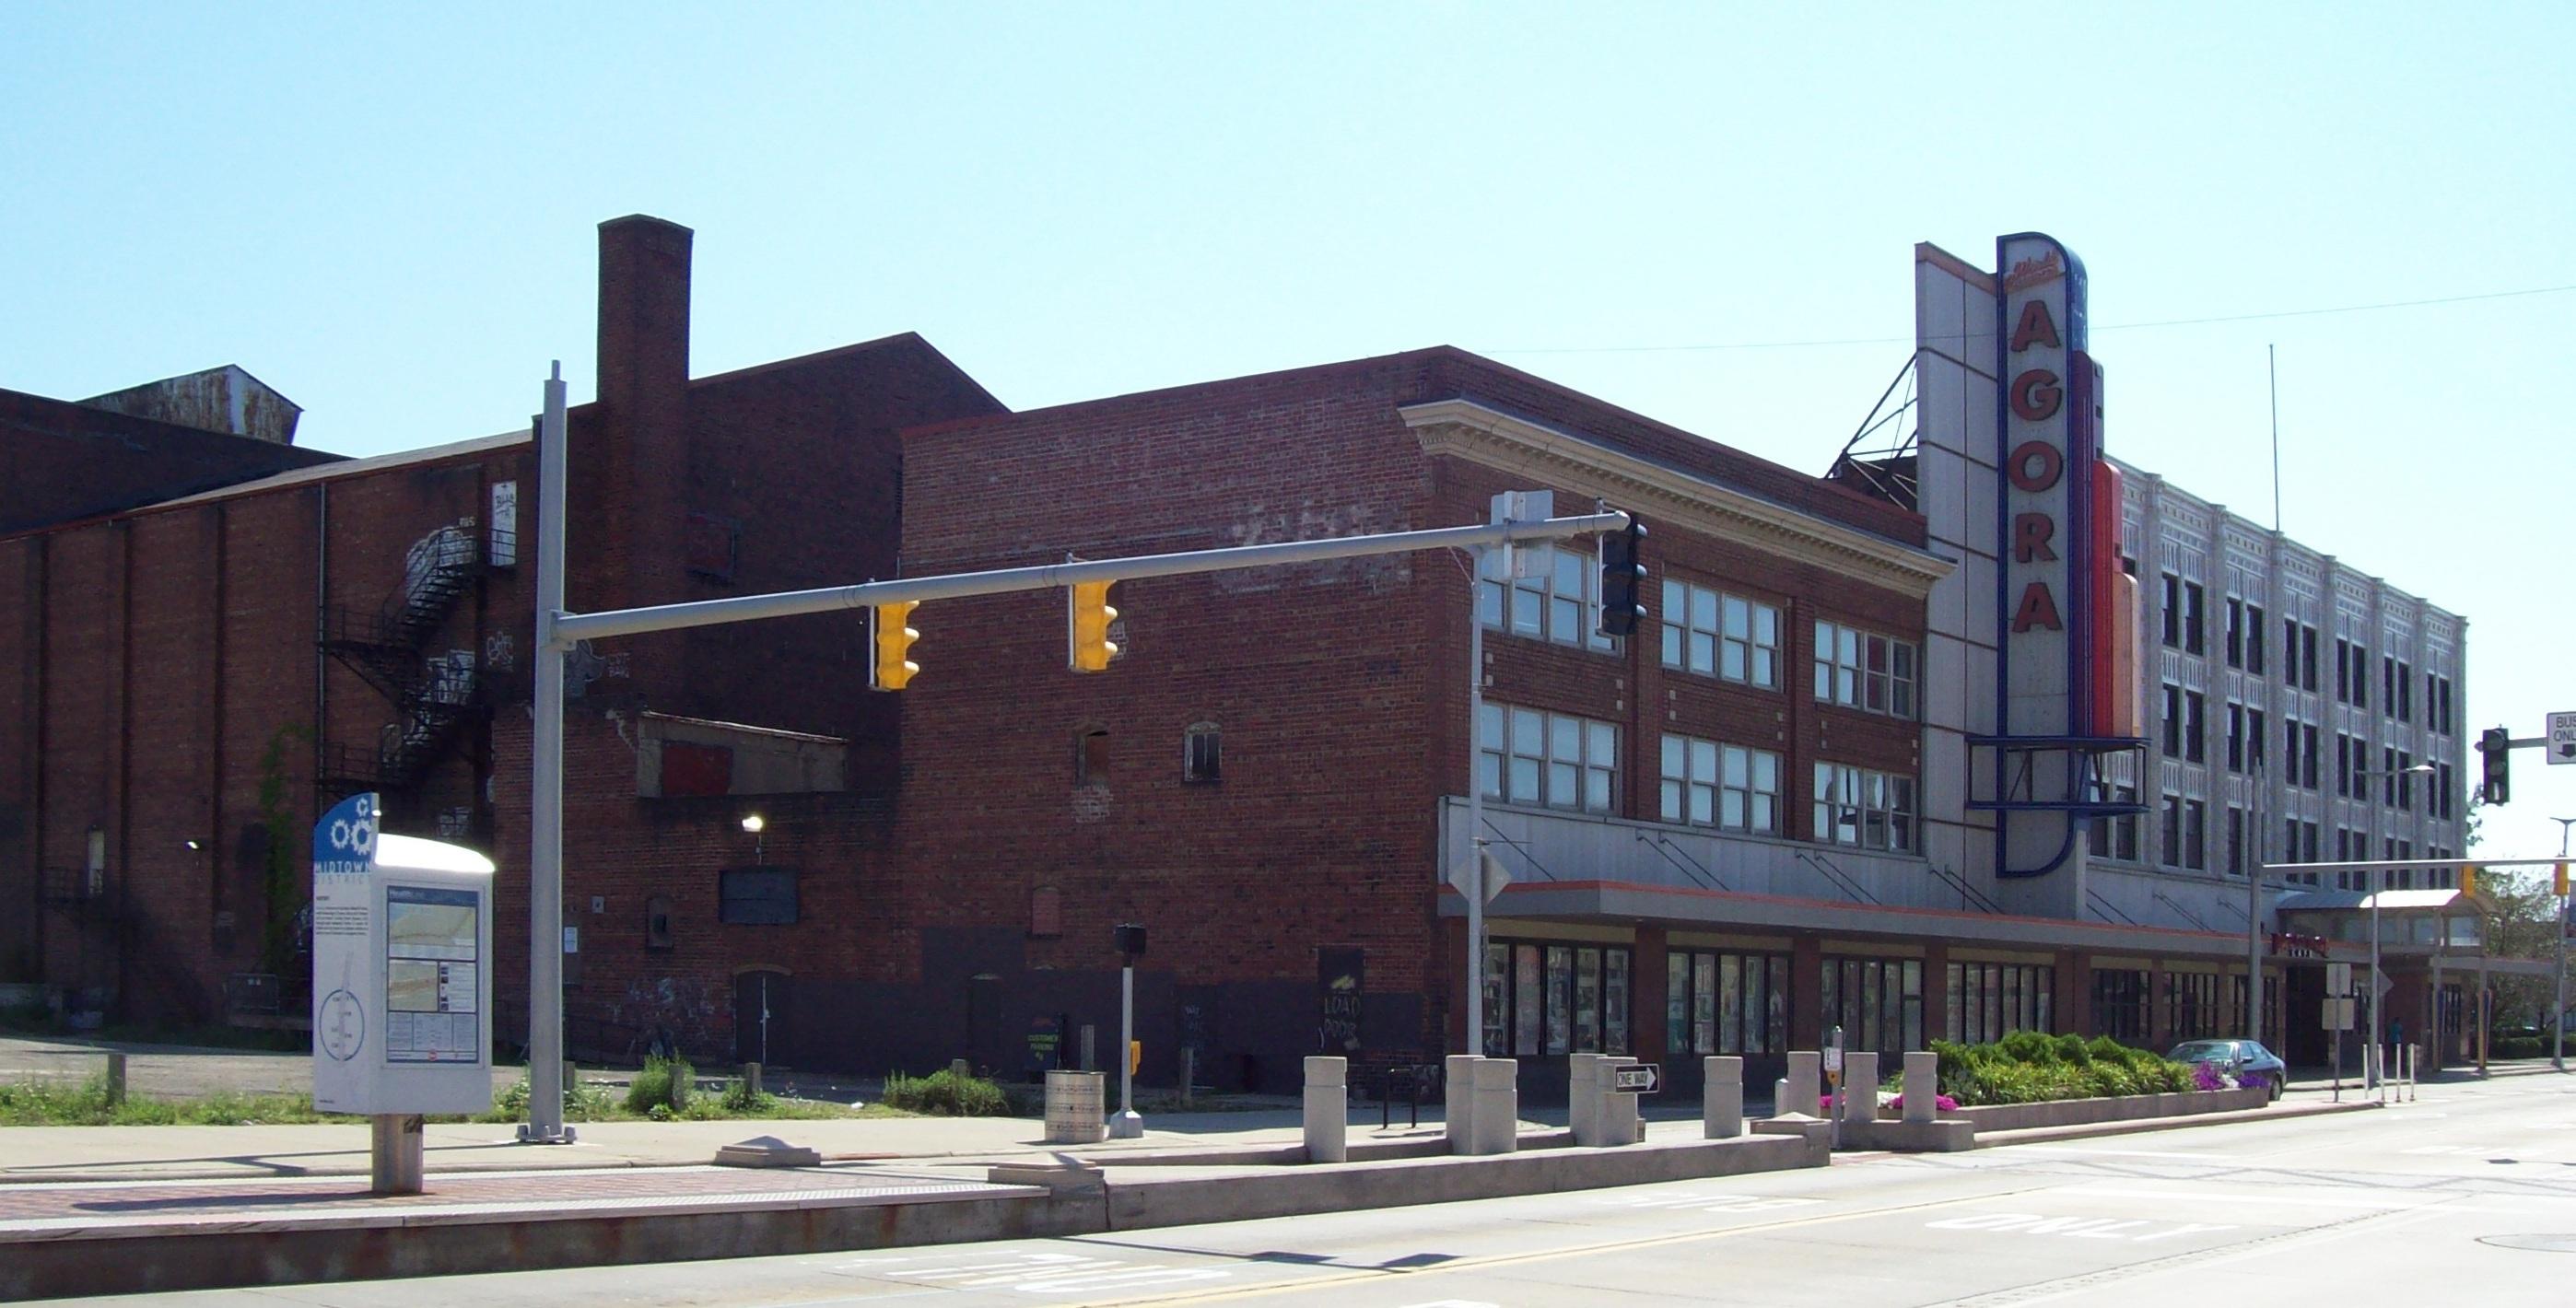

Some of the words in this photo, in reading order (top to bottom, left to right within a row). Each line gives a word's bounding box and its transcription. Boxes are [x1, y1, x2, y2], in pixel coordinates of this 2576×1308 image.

[2008, 299, 2063, 633] AGORA
[2553, 730, 2576, 742] ONL
[313, 860, 371, 873] MIDTOWN
[1618, 1073, 1632, 1086] ONE
[1634, 1073, 1646, 1085] WAY
[1924, 1212, 2242, 1241] ONLY
